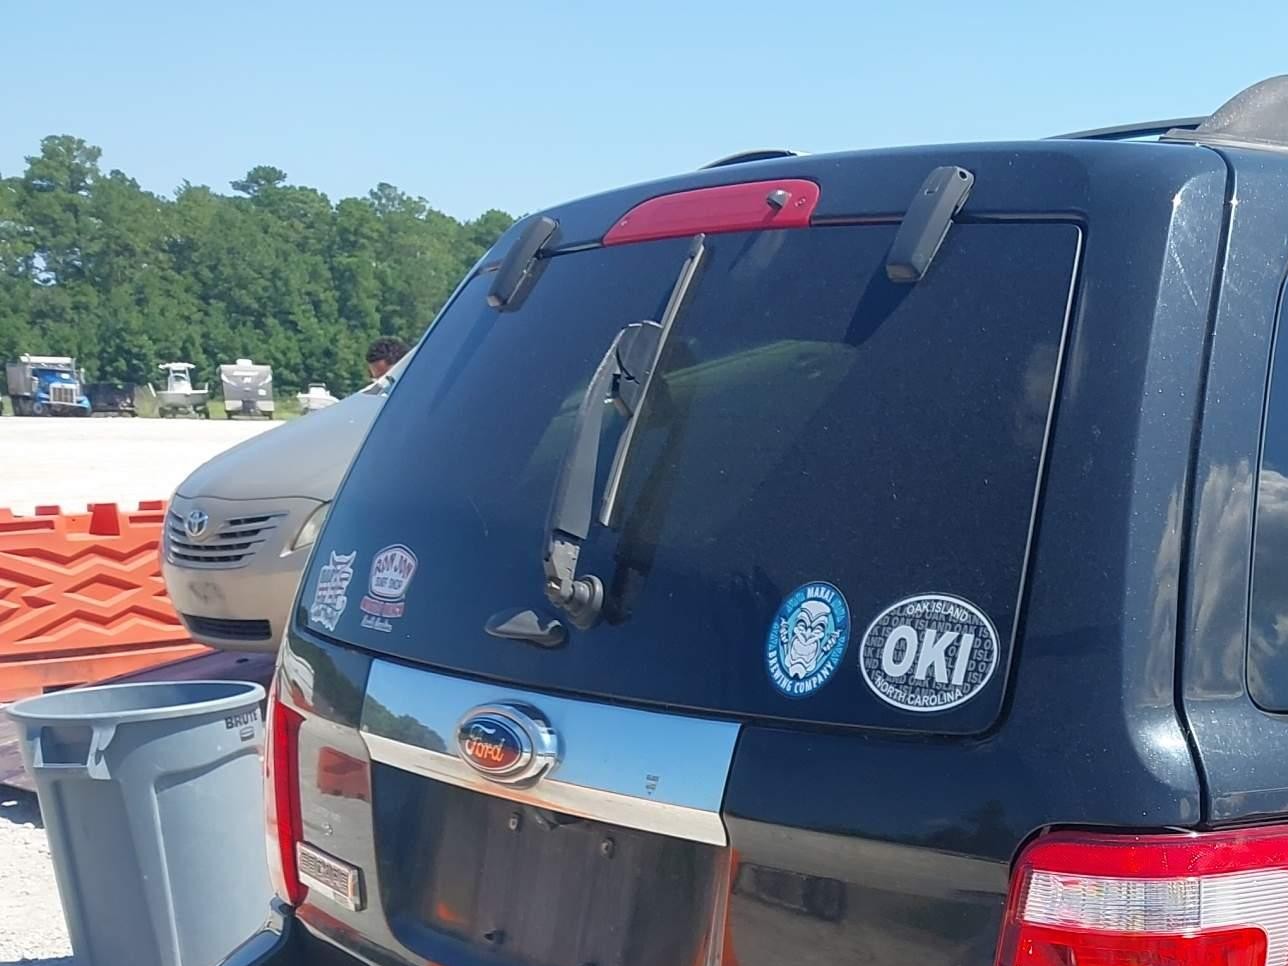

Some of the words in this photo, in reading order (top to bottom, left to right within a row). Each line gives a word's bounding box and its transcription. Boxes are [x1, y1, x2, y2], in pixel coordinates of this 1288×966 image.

[906, 602, 930, 615] OAK
[931, 602, 969, 622] ISLAND
[767, 650, 793, 693] BREWING
[793, 661, 835, 694] COMPANY
[882, 624, 976, 686] OKI
[874, 676, 906, 704] NORTH
[906, 688, 964, 707] CAROLINA
[225, 710, 258, 730] BRUTE
[465, 723, 507, 762] Ford
